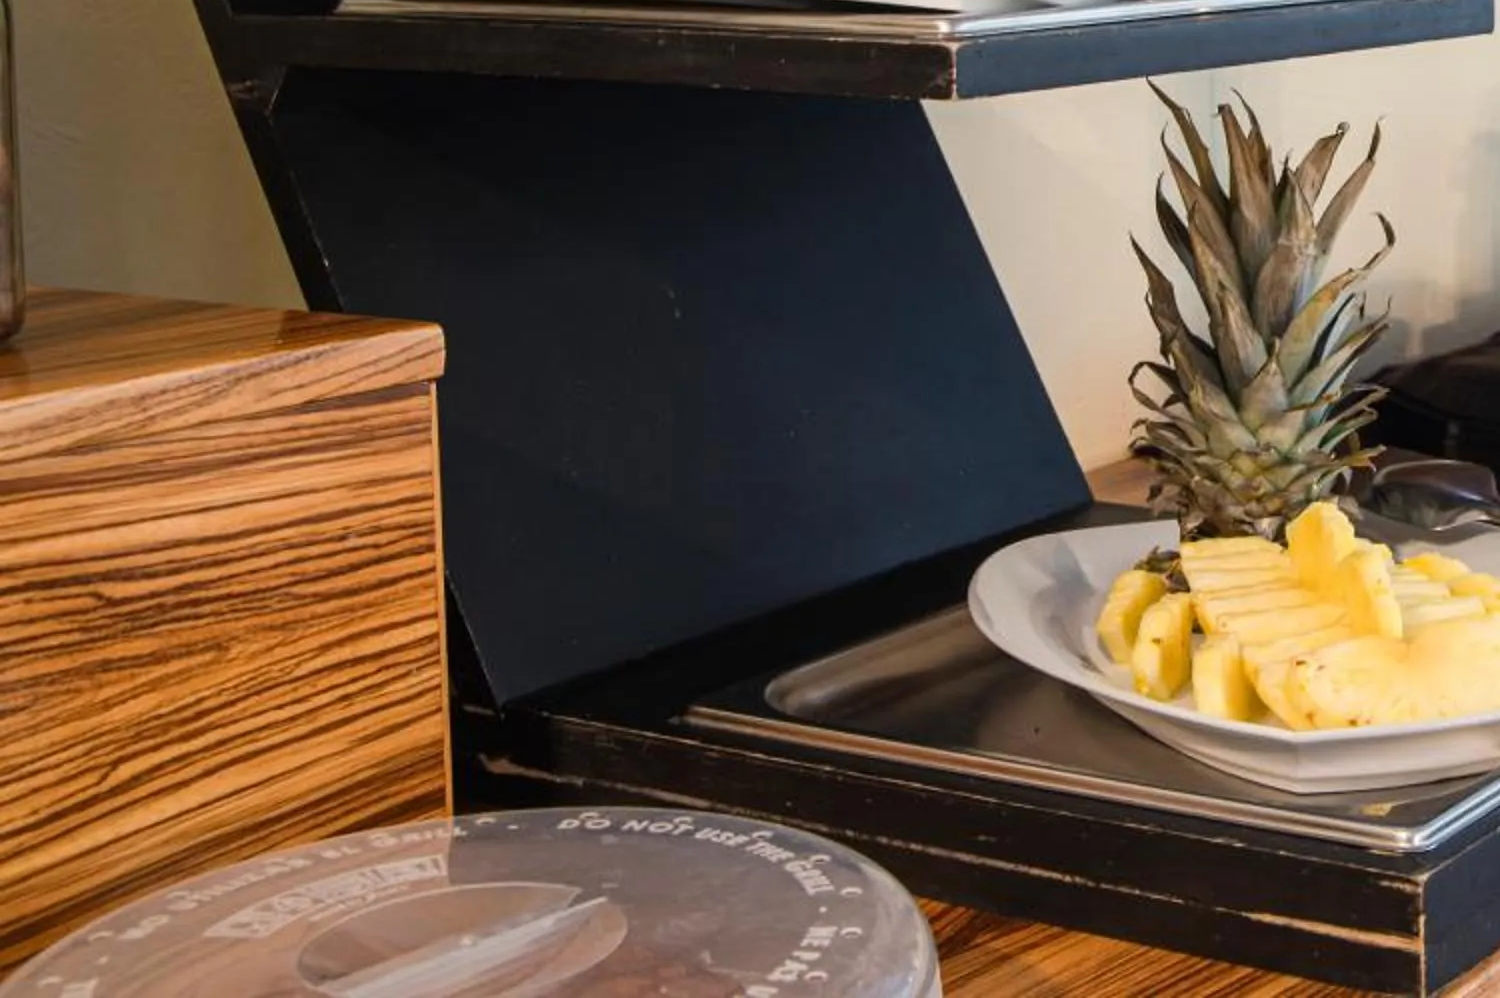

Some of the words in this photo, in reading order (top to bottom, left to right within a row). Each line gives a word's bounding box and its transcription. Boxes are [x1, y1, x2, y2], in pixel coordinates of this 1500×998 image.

[557, 818, 611, 830] DO
[621, 819, 694, 836] NOT
[694, 827, 750, 847] USE
[745, 840, 796, 863] THE
